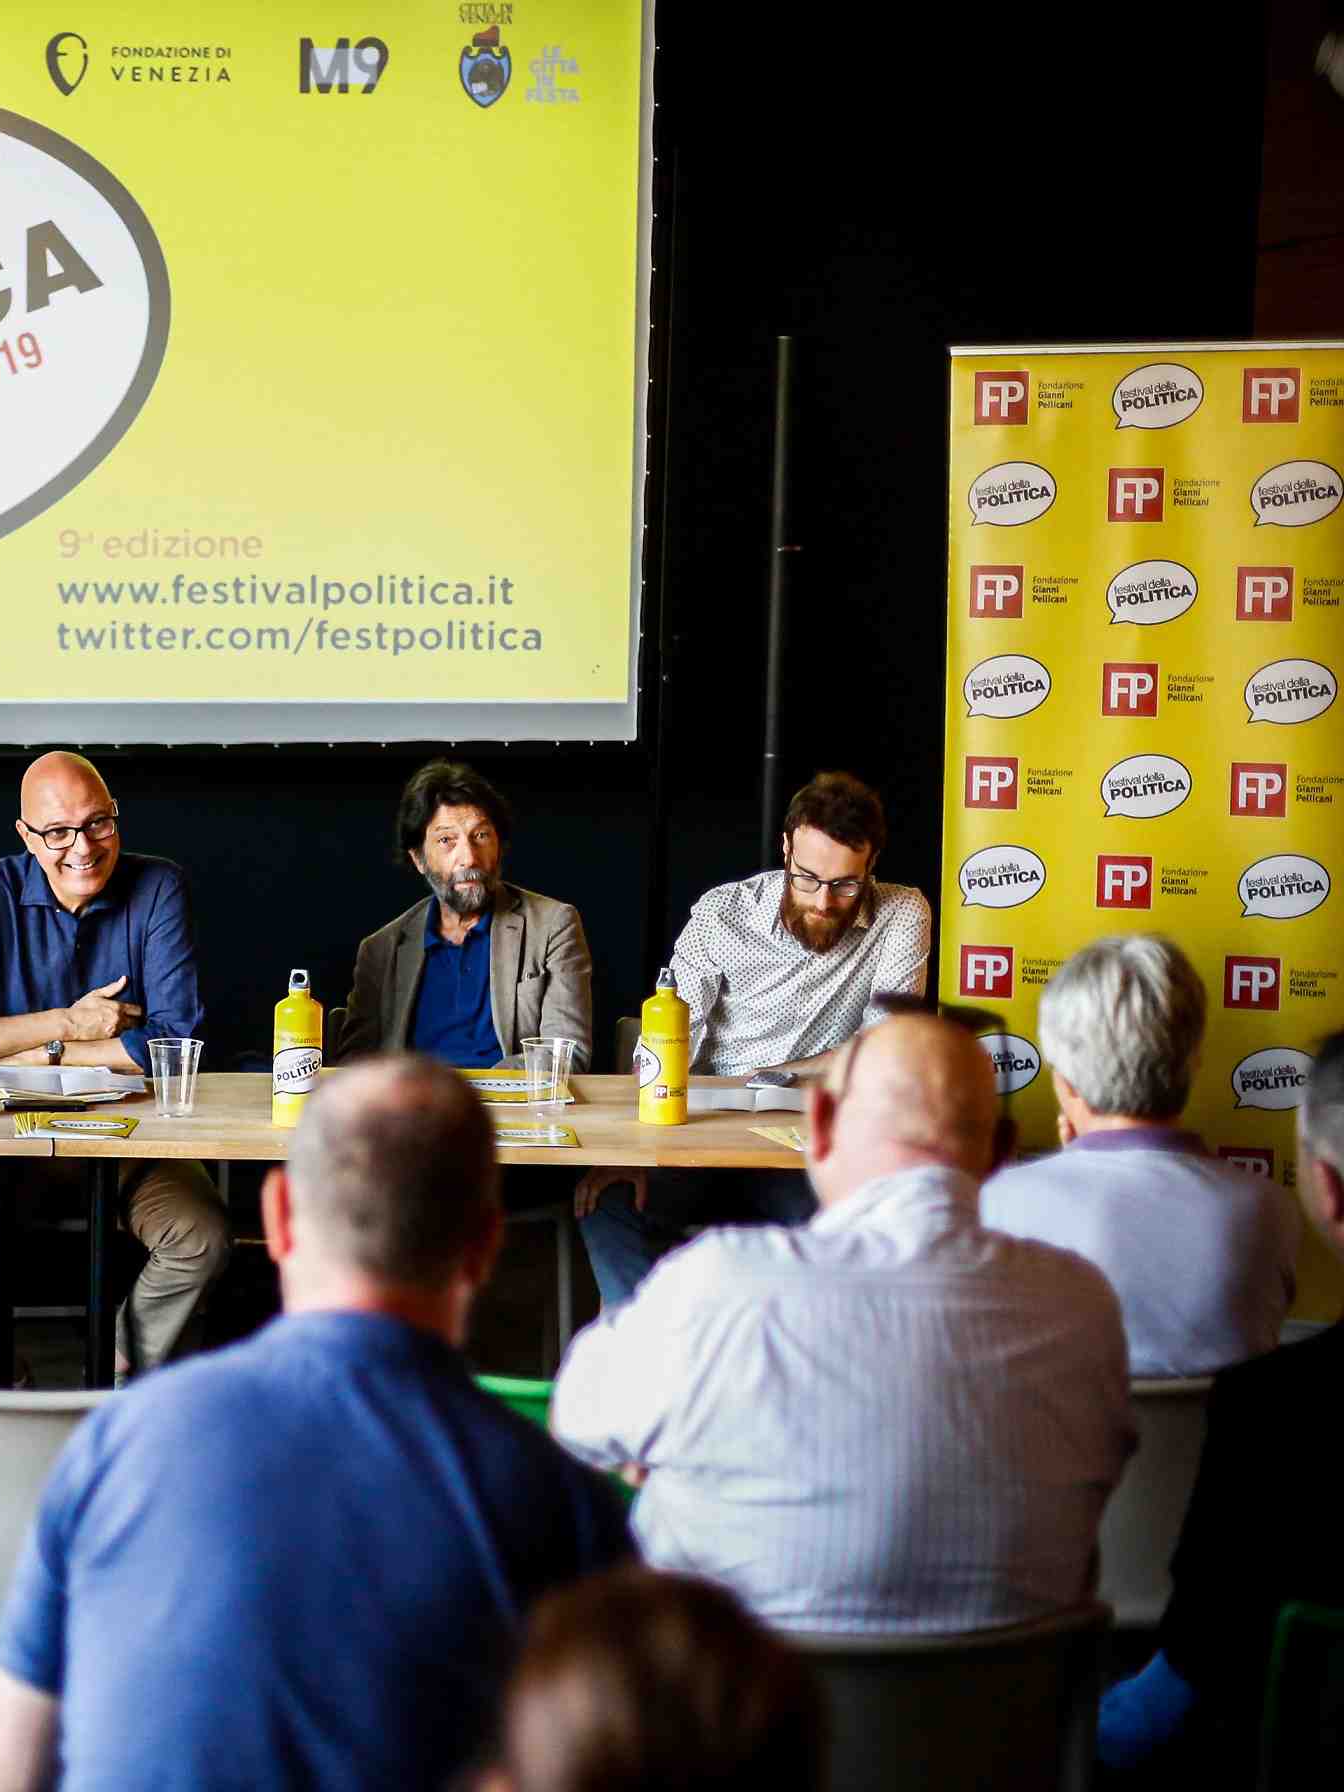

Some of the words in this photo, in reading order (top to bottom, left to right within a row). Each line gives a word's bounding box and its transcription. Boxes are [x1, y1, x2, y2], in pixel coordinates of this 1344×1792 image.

[111, 46, 209, 59] FONDAZIONE
[215, 46, 232, 59] DI
[111, 66, 232, 84] VENEZIA
[298, 36, 390, 95] M9
[982, 380, 1025, 417] FP
[1038, 391, 1065, 400] Gianni
[1038, 400, 1073, 409] Pellicani
[1121, 387, 1198, 411] POLITICA
[1250, 377, 1297, 416] FP
[1310, 397, 1344, 406] Pellican
[977, 485, 1051, 509] POLITICA
[1116, 477, 1159, 515] FP
[1173, 488, 1201, 497] Gianni
[1173, 497, 1209, 507] Pellicani
[1259, 485, 1339, 509] POLITICA
[102, 528, 265, 560] edizione
[57, 575, 514, 611] www.festivalpolitica.it
[976, 575, 1019, 610] FP
[1032, 586, 1060, 594] Gianni
[1032, 595, 1068, 604] Pellicani
[1116, 584, 1193, 607] POLITICA
[1245, 576, 1289, 613] FP
[57, 617, 544, 656] twitter.com/festpolitica
[972, 679, 1046, 700] POLITICA
[1110, 672, 1153, 709] FP
[1167, 683, 1195, 693] Gianni
[1167, 693, 1203, 702] Pellicani
[1254, 683, 1332, 706] POLITICA
[972, 766, 1014, 801] FP
[1027, 778, 1054, 786] Gianni
[1027, 787, 1062, 796] Pellicani
[1110, 778, 1186, 801] POLITICA
[1238, 771, 1283, 808] FP
[967, 870, 1040, 890] POLITICA
[1104, 864, 1148, 901] FP
[1161, 877, 1188, 886] Gianni
[1161, 886, 1197, 895] Pellicani
[1247, 878, 1325, 901] POLITICA
[966, 953, 1010, 990] FP
[1231, 964, 1276, 1001] FP
[1241, 1074, 1306, 1092] POLITIC
